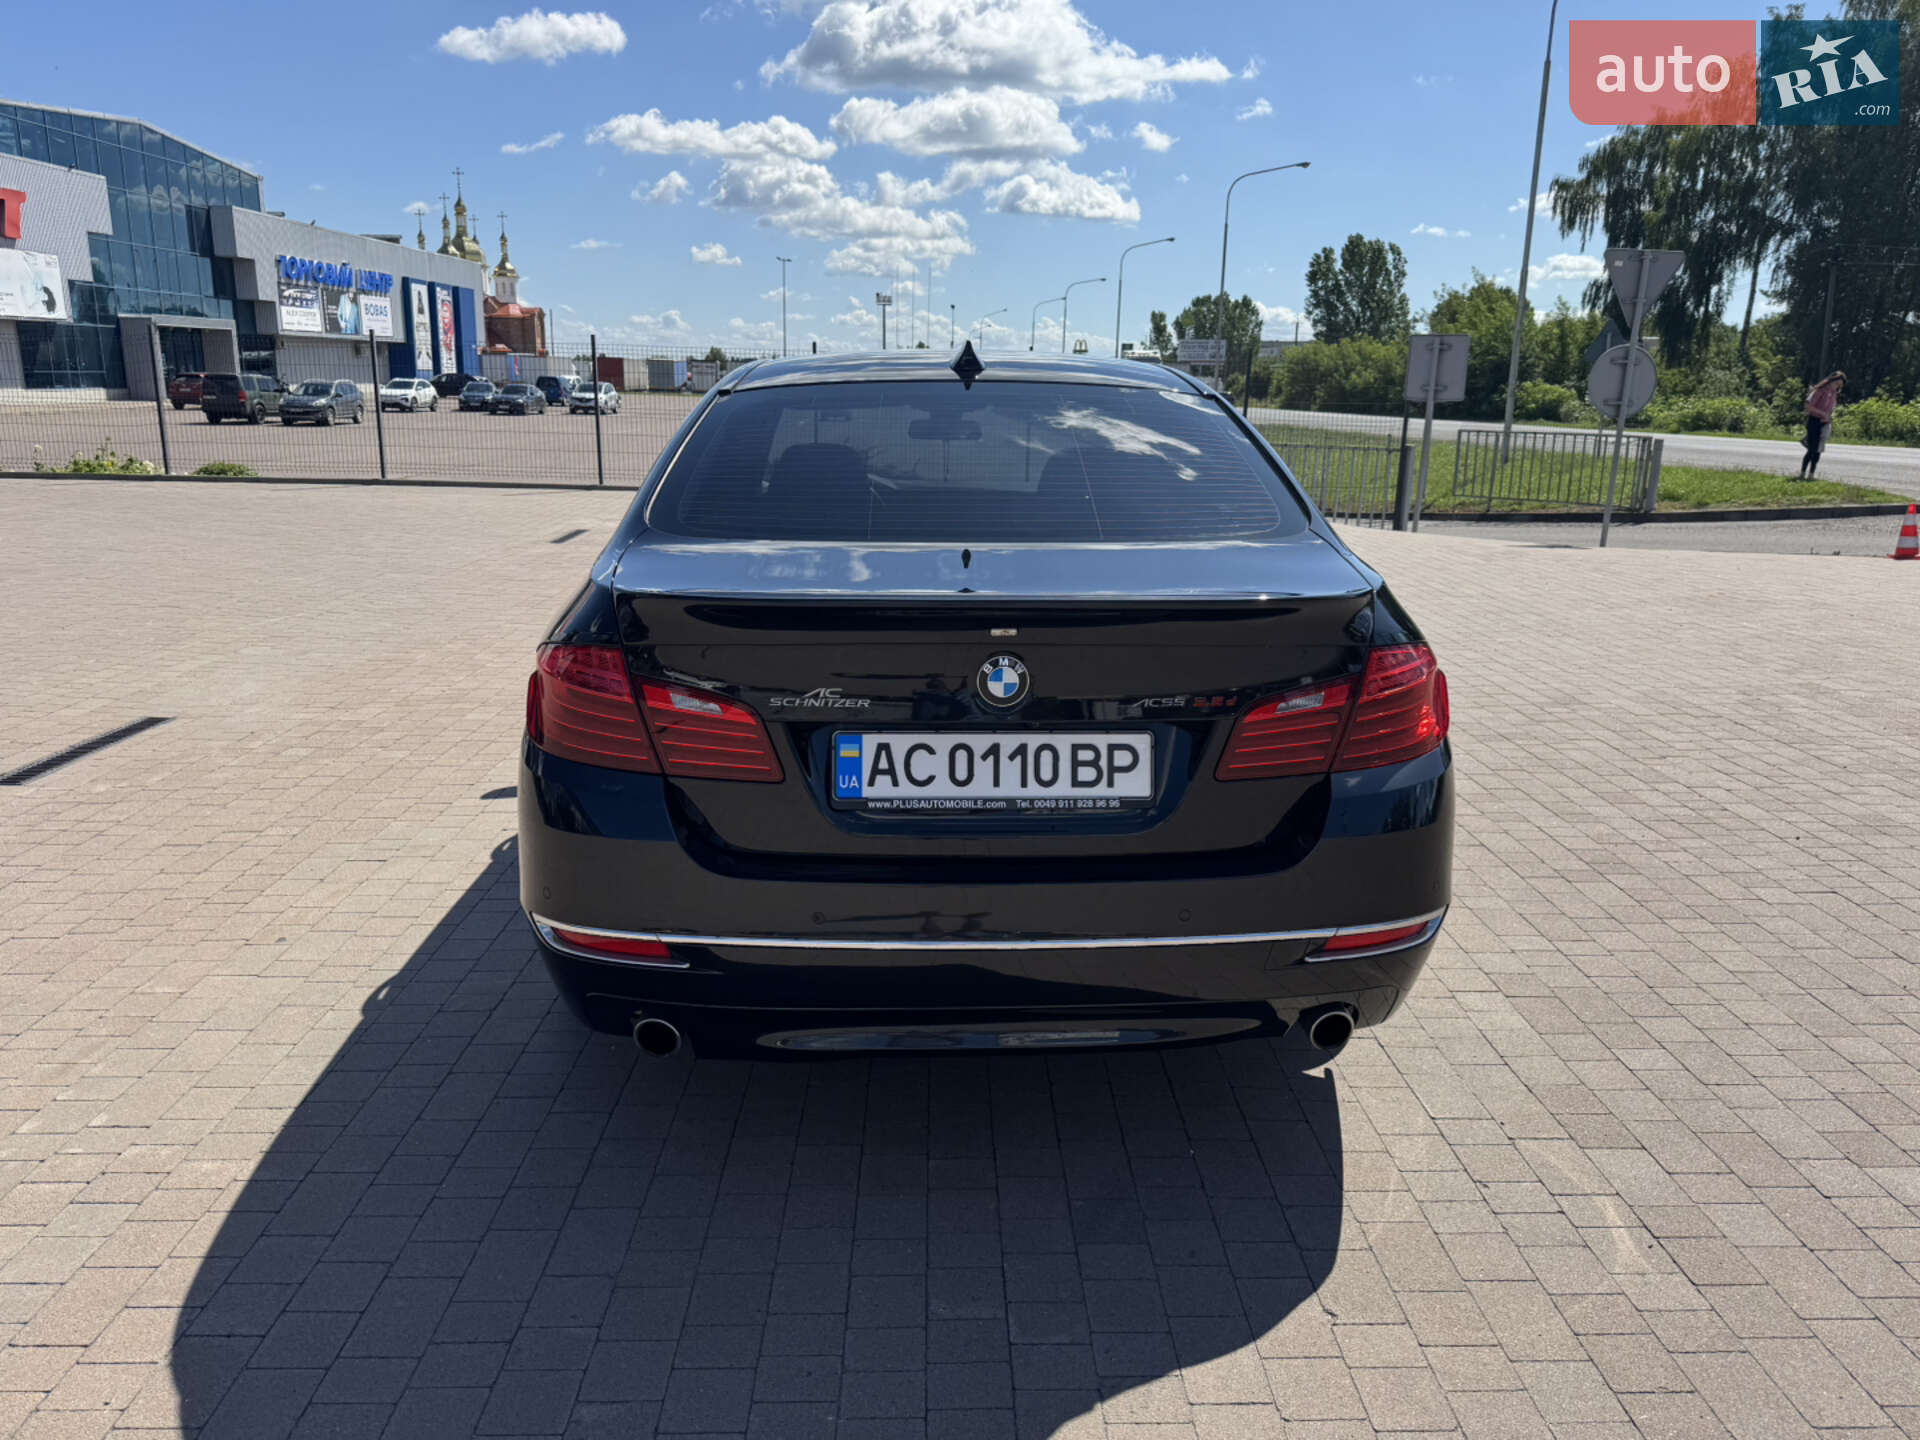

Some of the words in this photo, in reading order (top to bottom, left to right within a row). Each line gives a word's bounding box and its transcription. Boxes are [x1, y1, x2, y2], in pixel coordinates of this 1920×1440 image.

[277, 255, 353, 288] ТОРГОВИЙ
[358, 268, 393, 294] ЦЕНТР
[983, 656, 1025, 674] BMW
[802, 687, 843, 697] AC
[769, 697, 871, 708] SCHNITZER
[839, 775, 860, 788] UA
[867, 799, 1007, 809] www.PLUSAUTOMOBILE.com
